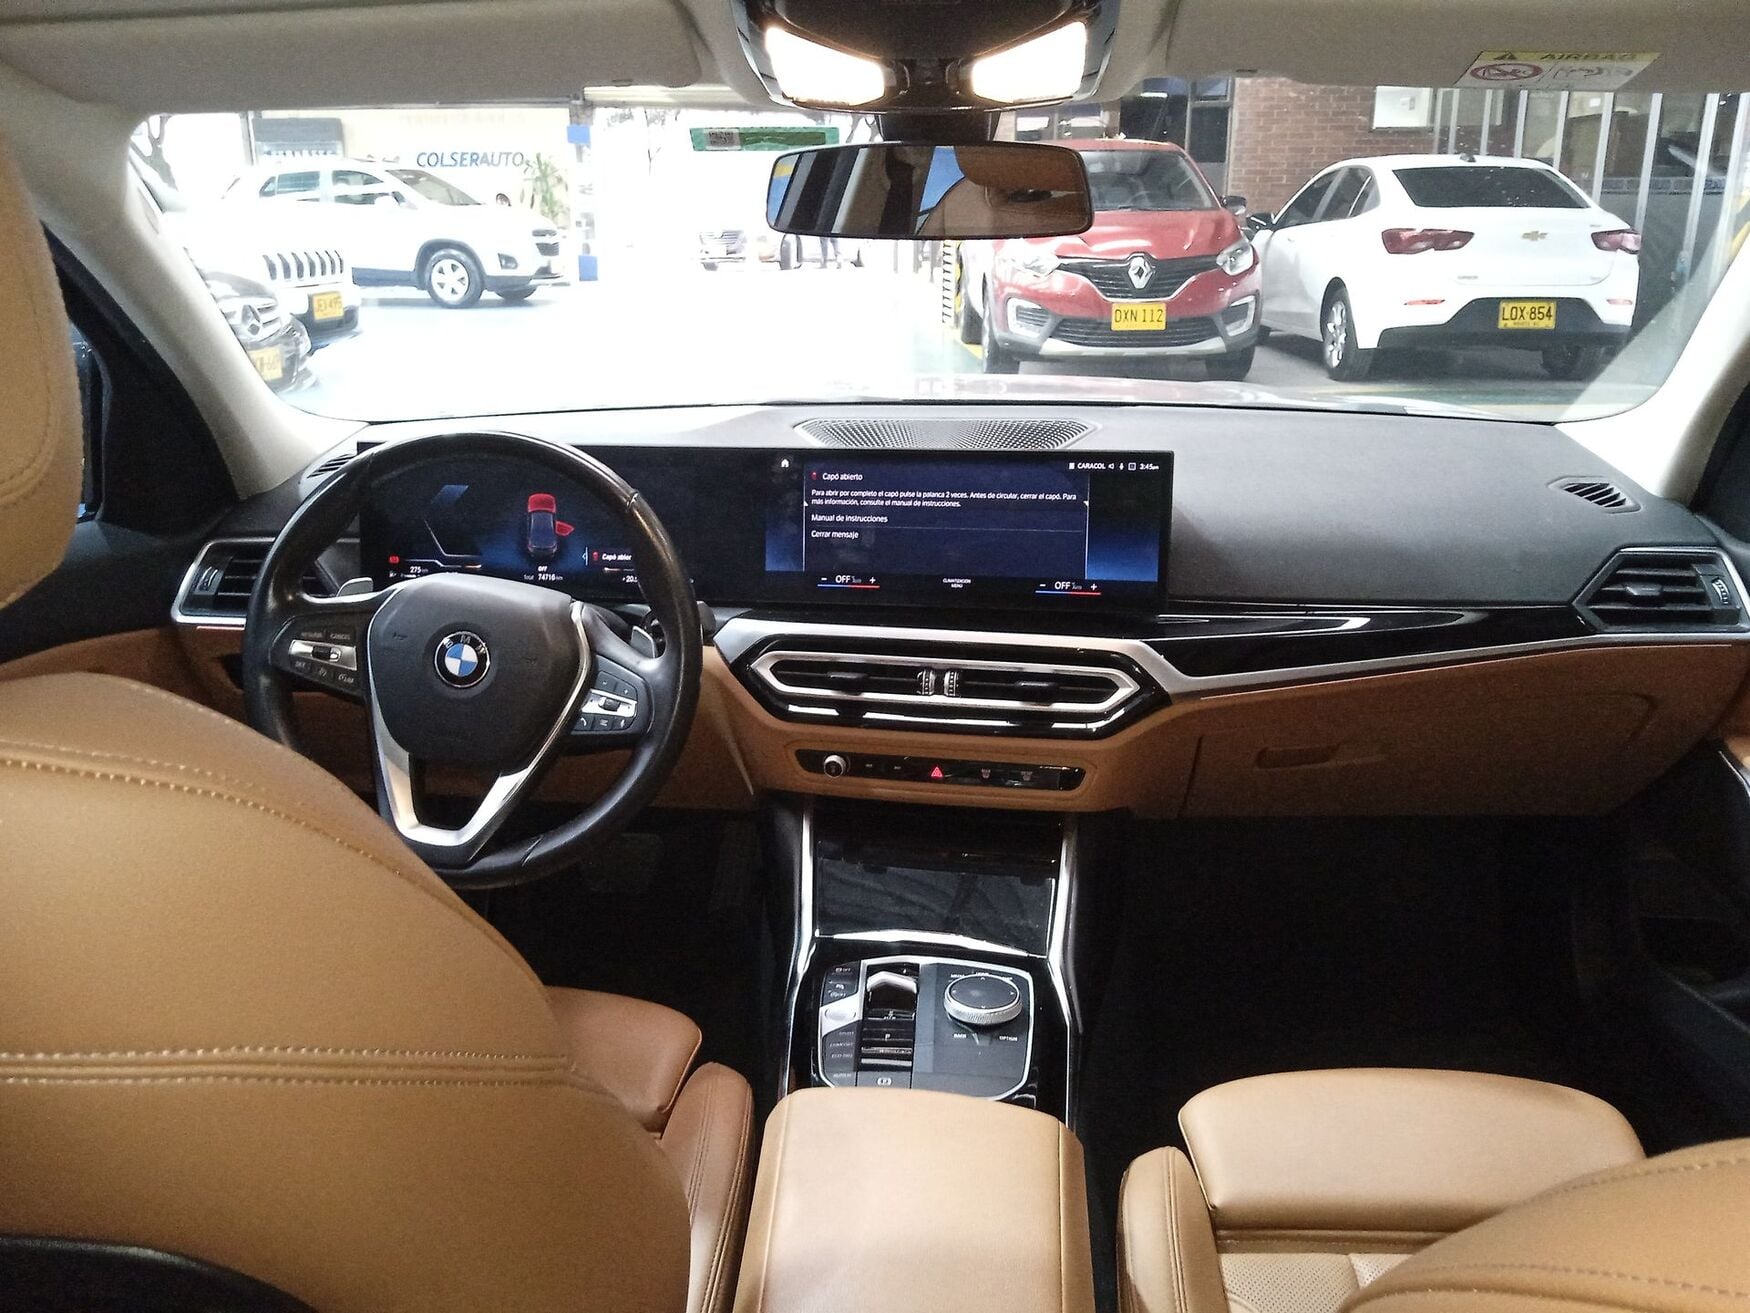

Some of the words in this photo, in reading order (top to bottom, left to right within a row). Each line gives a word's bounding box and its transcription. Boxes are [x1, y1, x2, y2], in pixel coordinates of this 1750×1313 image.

[416, 151, 524, 168] COLSERAUTO
[1114, 308, 1137, 323] DXN
[1142, 308, 1164, 323] 112
[1502, 306, 1526, 321] LOX
[1529, 306, 1553, 321] 854
[1077, 462, 1106, 470] CARACOL
[822, 472, 839, 482] Capó
[840, 472, 863, 481] abierto
[811, 489, 825, 497] Para
[825, 489, 839, 497] abrir
[839, 490, 850, 498] por
[850, 489, 878, 498] completo
[884, 490, 899, 499] capó
[899, 490, 915, 499] pulse
[922, 490, 945, 499] palanca
[970, 491, 987, 499] Antes
[1038, 492, 1045, 500] el
[1062, 493, 1077, 501] Para
[811, 497, 824, 505] más
[824, 498, 860, 507] información,
[860, 499, 884, 507] consulte
[891, 499, 912, 507] manual
[921, 499, 961, 508] instrucciones.
[811, 513, 835, 522] Manual
[835, 514, 845, 522] de
[845, 514, 889, 523] instrucciones
[811, 529, 831, 539] Cerrar
[832, 530, 859, 540] mensaje
[601, 553, 617, 563] Capó
[410, 565, 422, 574] 275
[835, 574, 851, 584] OFF
[1054, 581, 1071, 590] OFF
